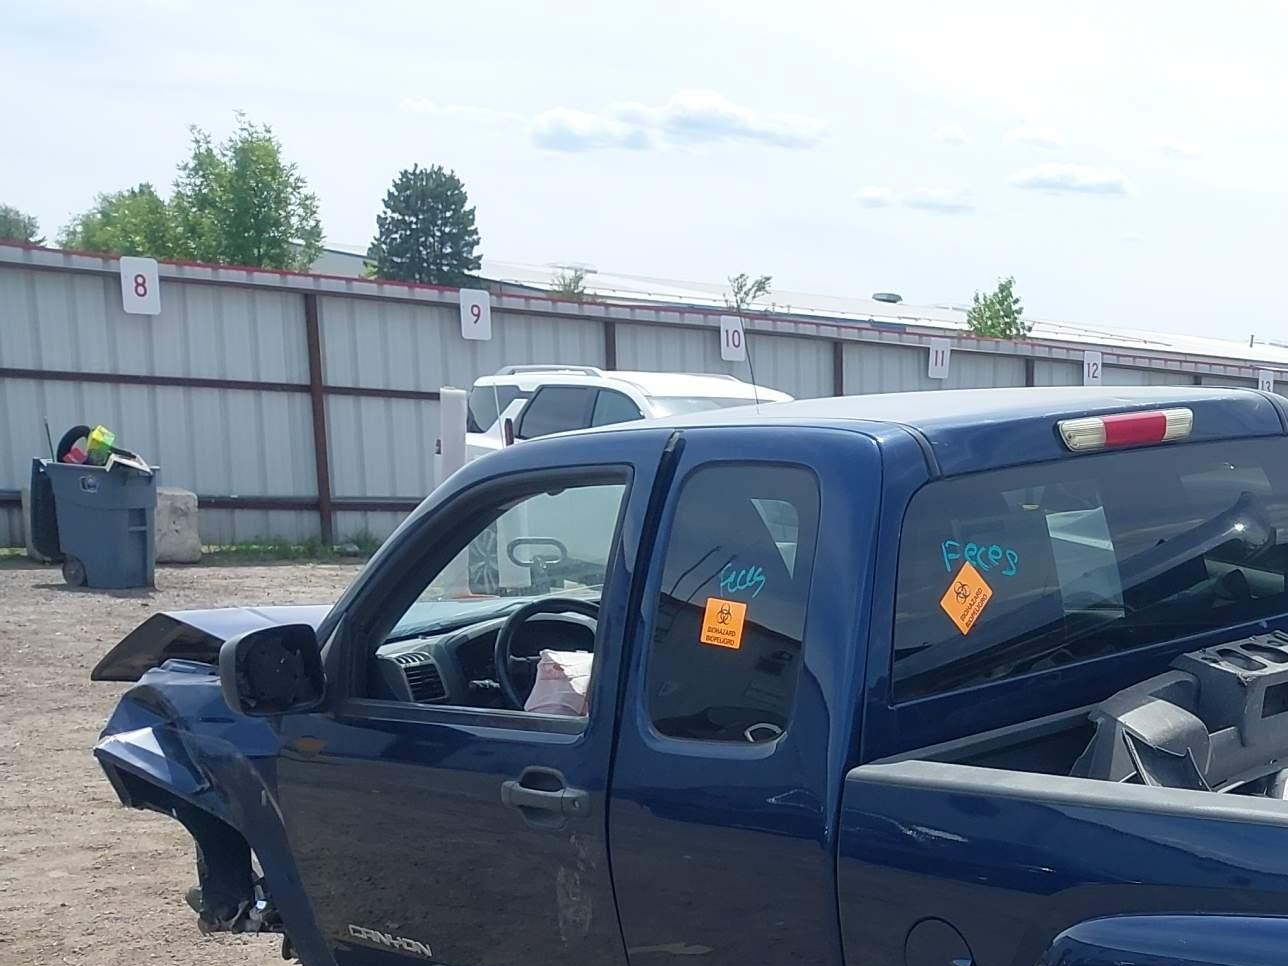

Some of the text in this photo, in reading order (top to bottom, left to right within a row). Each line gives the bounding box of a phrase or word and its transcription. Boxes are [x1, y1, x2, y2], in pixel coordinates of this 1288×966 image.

[134, 274, 147, 297] 8
[470, 304, 482, 324] 9
[725, 329, 741, 348] 10
[934, 349, 945, 368] 11
[1086, 362, 1099, 379] 12
[942, 540, 1018, 576] Feces
[960, 587, 983, 622] BIOHAZARD
[706, 626, 736, 637] BIOHAZARD
[348, 924, 432, 957] CANYON
